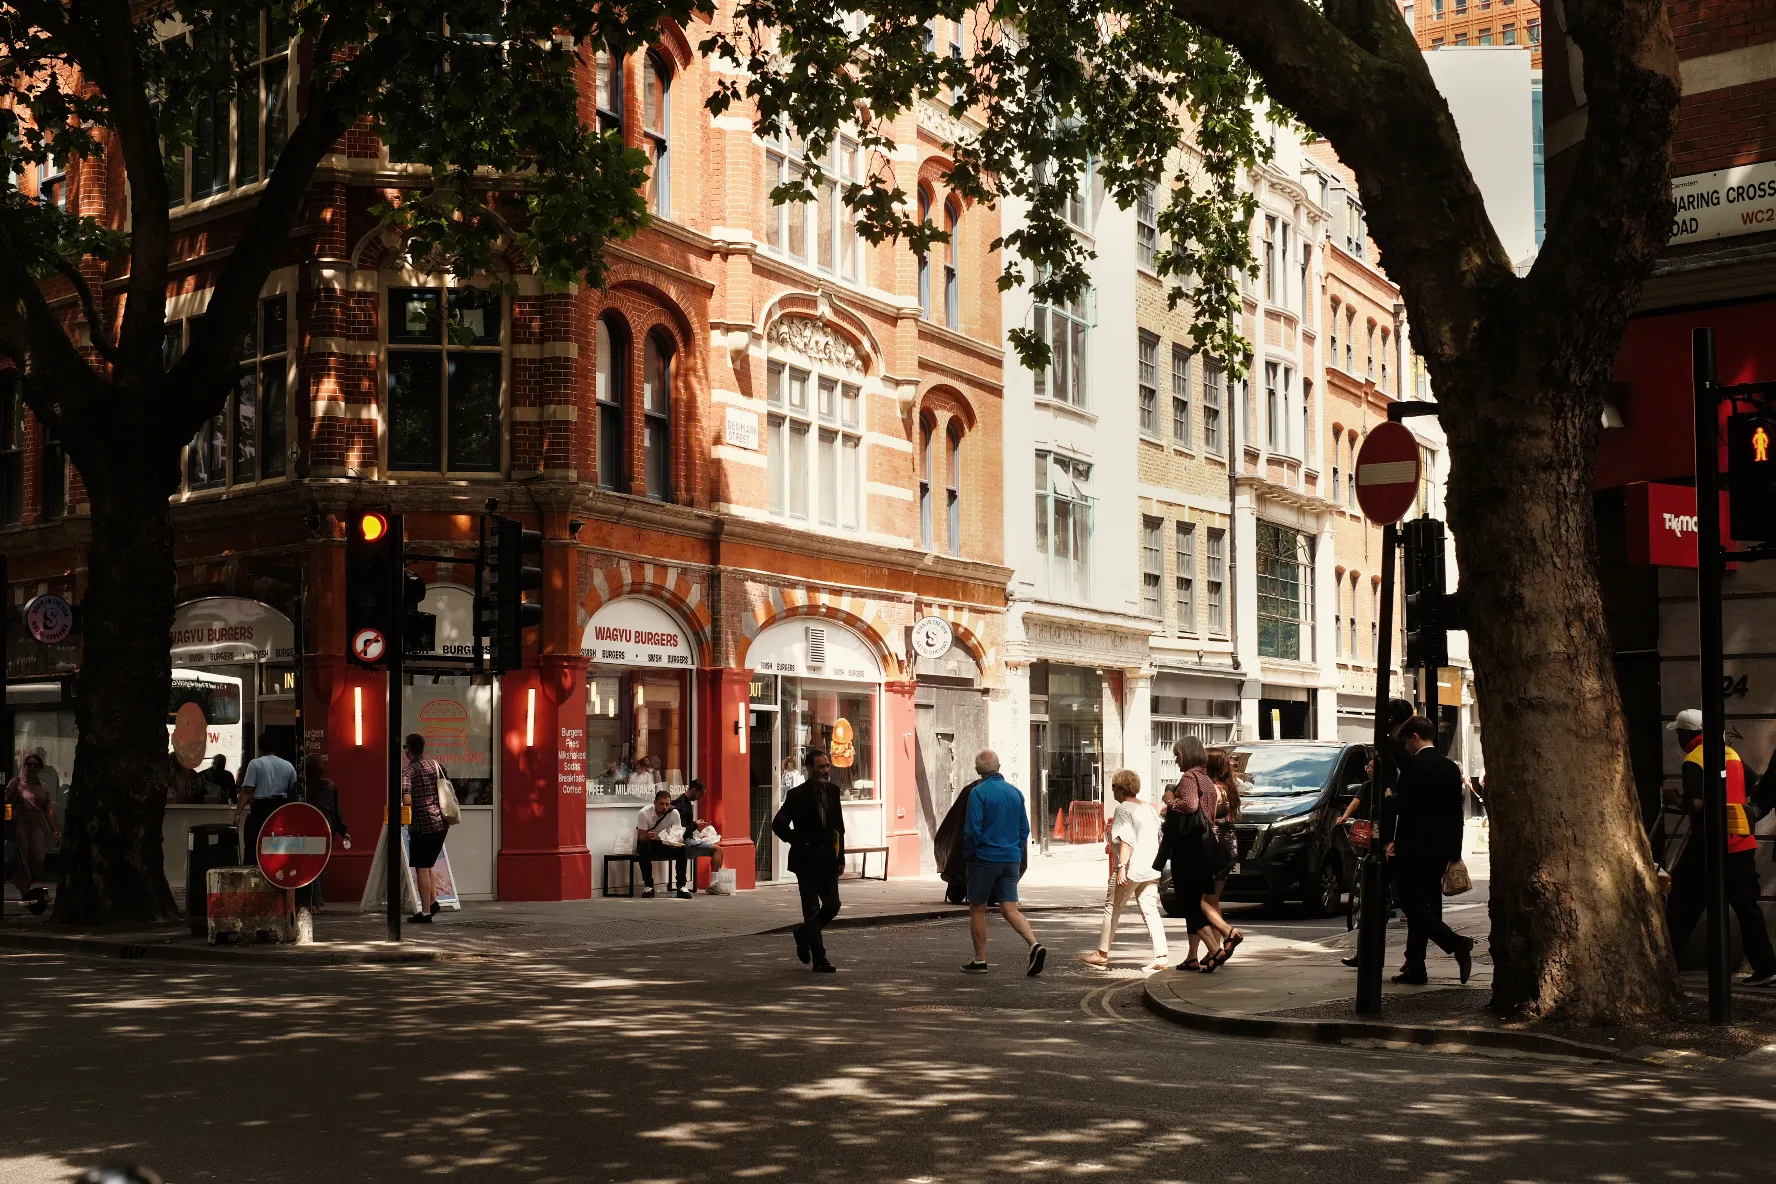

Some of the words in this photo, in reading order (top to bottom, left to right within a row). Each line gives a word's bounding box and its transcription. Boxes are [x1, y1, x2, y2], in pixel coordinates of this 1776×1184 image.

[1671, 181, 1698, 189] Camden
[1726, 180, 1776, 204] CROSS
[1670, 217, 1699, 237] OAD
[727, 420, 758, 437] DENMARK
[728, 431, 750, 444] STREET
[208, 626, 254, 642] BURGERS
[594, 626, 632, 643] WAGYU
[634, 630, 679, 648] BURGERS
[210, 652, 234, 661] BURGERS
[602, 650, 626, 660] BURGERS
[668, 655, 689, 664] BURGERS
[776, 662, 796, 672] BURGERS
[848, 670, 865, 678] BURGERS
[1722, 675, 1749, 697] 24
[562, 728, 583, 738] Burgers
[306, 741, 321, 750] Fries
[566, 738, 580, 748] Fries
[558, 750, 586, 760] Milkshakes
[564, 762, 582, 771] Sodas
[558, 774, 586, 782] Breakfast
[562, 784, 582, 794] Coffee
[615, 784, 656, 796] MILKSHAKES
